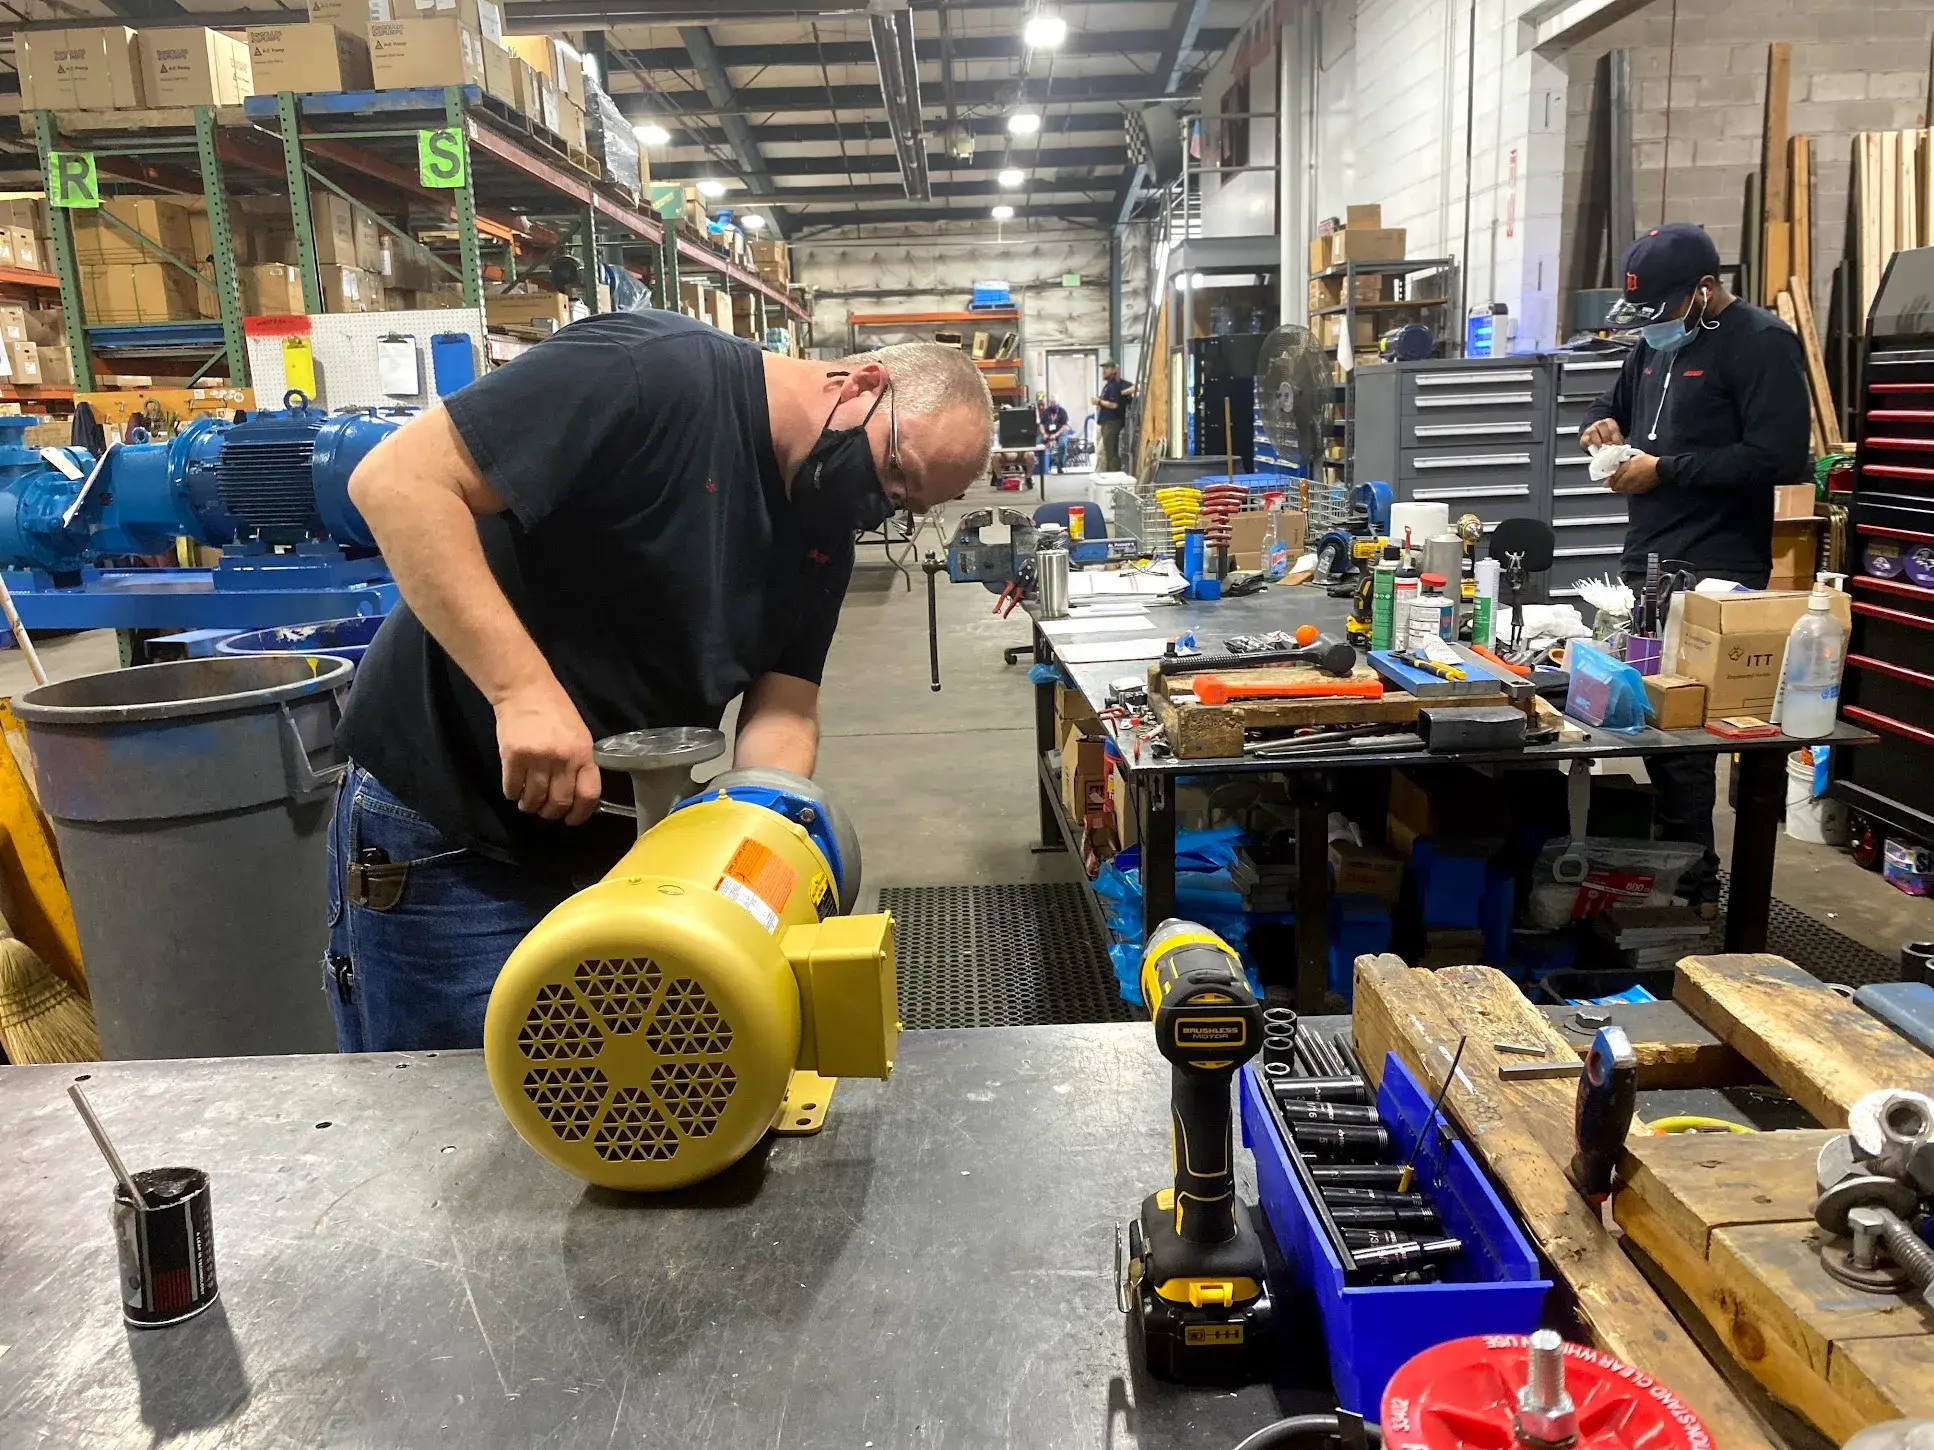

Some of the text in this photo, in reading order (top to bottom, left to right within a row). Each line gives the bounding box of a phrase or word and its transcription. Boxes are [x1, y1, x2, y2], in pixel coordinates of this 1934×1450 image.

[428, 132, 462, 180] S
[58, 153, 95, 200] R
[1747, 653, 1774, 667] ITT
[1483, 1336, 1519, 1349] USE
[1598, 1355, 1654, 1388] CLEAR
